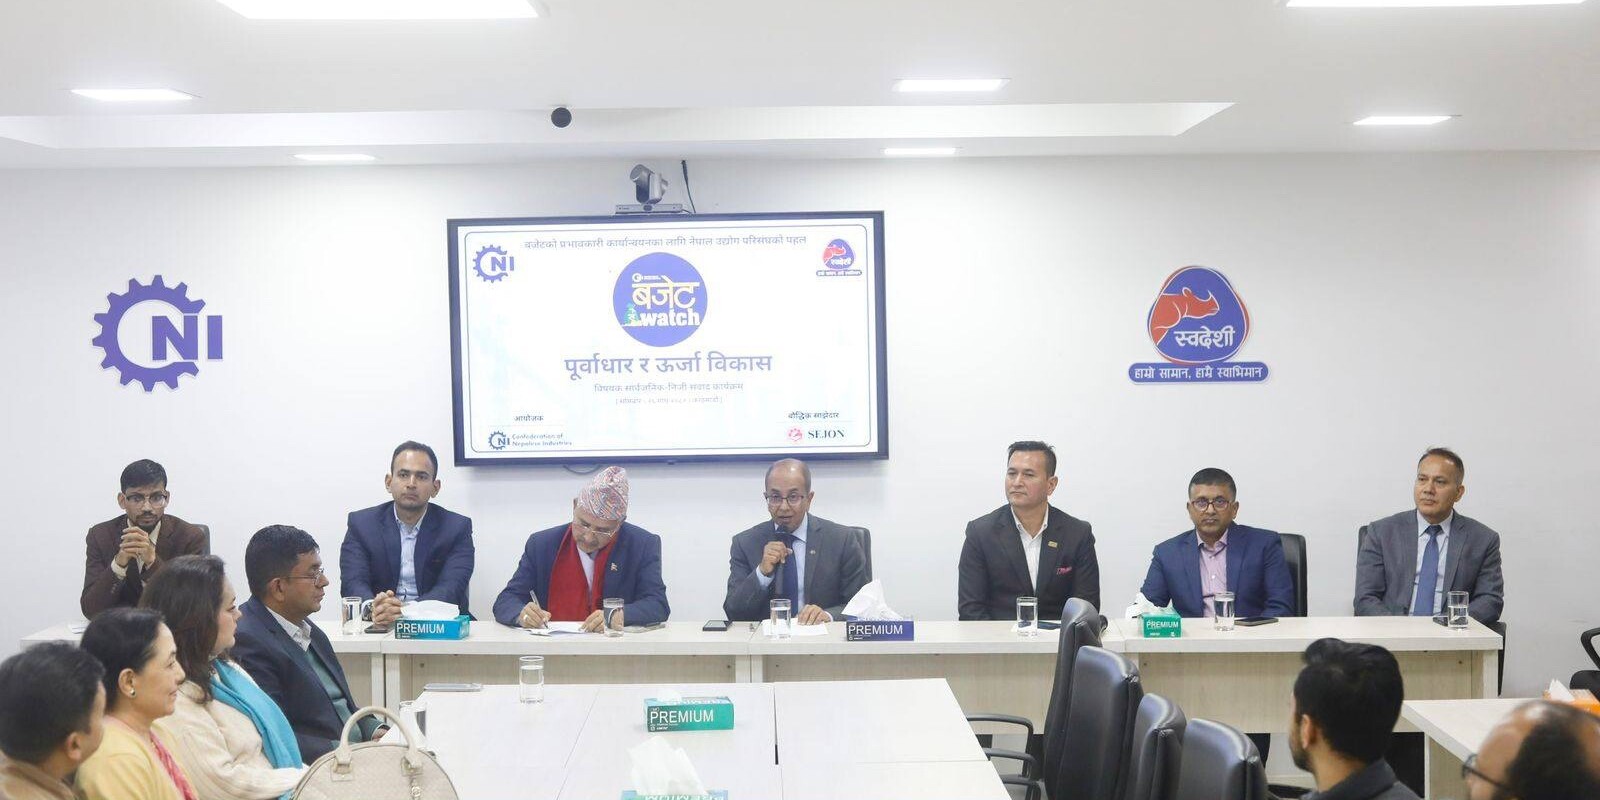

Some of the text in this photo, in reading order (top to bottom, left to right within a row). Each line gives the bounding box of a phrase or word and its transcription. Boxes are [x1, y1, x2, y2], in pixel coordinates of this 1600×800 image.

[560, 237, 603, 249] प्रभावकारी
[665, 235, 686, 246] लागि
[688, 236, 713, 246] नेपाल
[716, 236, 740, 246] उद्योग
[787, 235, 807, 244] पहल
[632, 274, 700, 310] बजेट
[640, 307, 701, 327] watch
[1174, 325, 1235, 350] स्वदेशी
[564, 350, 773, 381] पूर्वाधार र ऊर्जा विकास
[1134, 366, 1156, 379] हाम्रो
[1217, 365, 1263, 378] स्वाभिमान
[513, 413, 545, 422] आयोजक
[807, 429, 845, 439] SEJON
[396, 623, 445, 634] PREMIUM
[848, 624, 903, 635] PREMIUM
[1146, 620, 1179, 629] PREMIUM
[650, 709, 714, 724] PREMIUM
